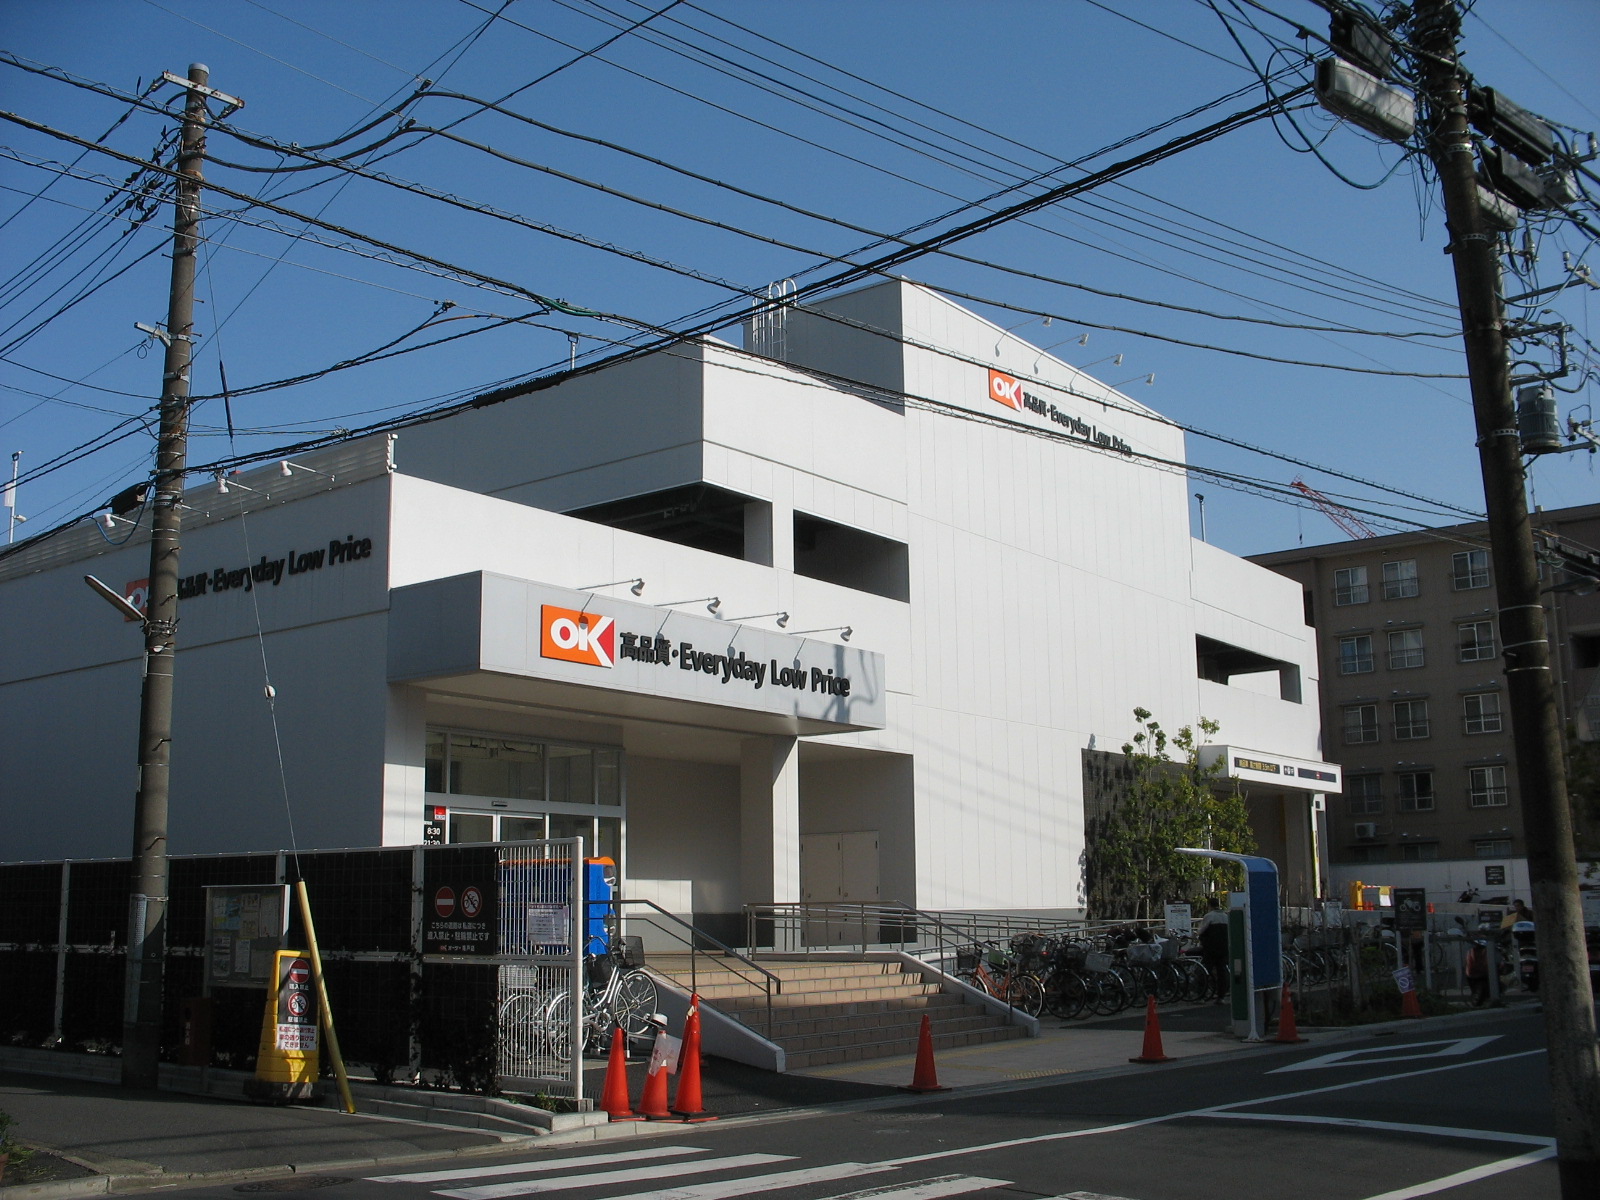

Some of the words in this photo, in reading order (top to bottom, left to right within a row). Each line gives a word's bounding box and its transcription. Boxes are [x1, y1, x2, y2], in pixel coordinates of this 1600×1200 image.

[993, 377, 1022, 411] OK
[1092, 425, 1111, 445] Low
[213, 556, 286, 593] Everyday
[288, 549, 326, 576] Low
[328, 535, 372, 566] Price
[550, 615, 615, 668] OK
[679, 642, 766, 689] Everyday
[770, 659, 808, 690] Low
[810, 666, 851, 697] Price
[427, 827, 441, 836] 8:30
